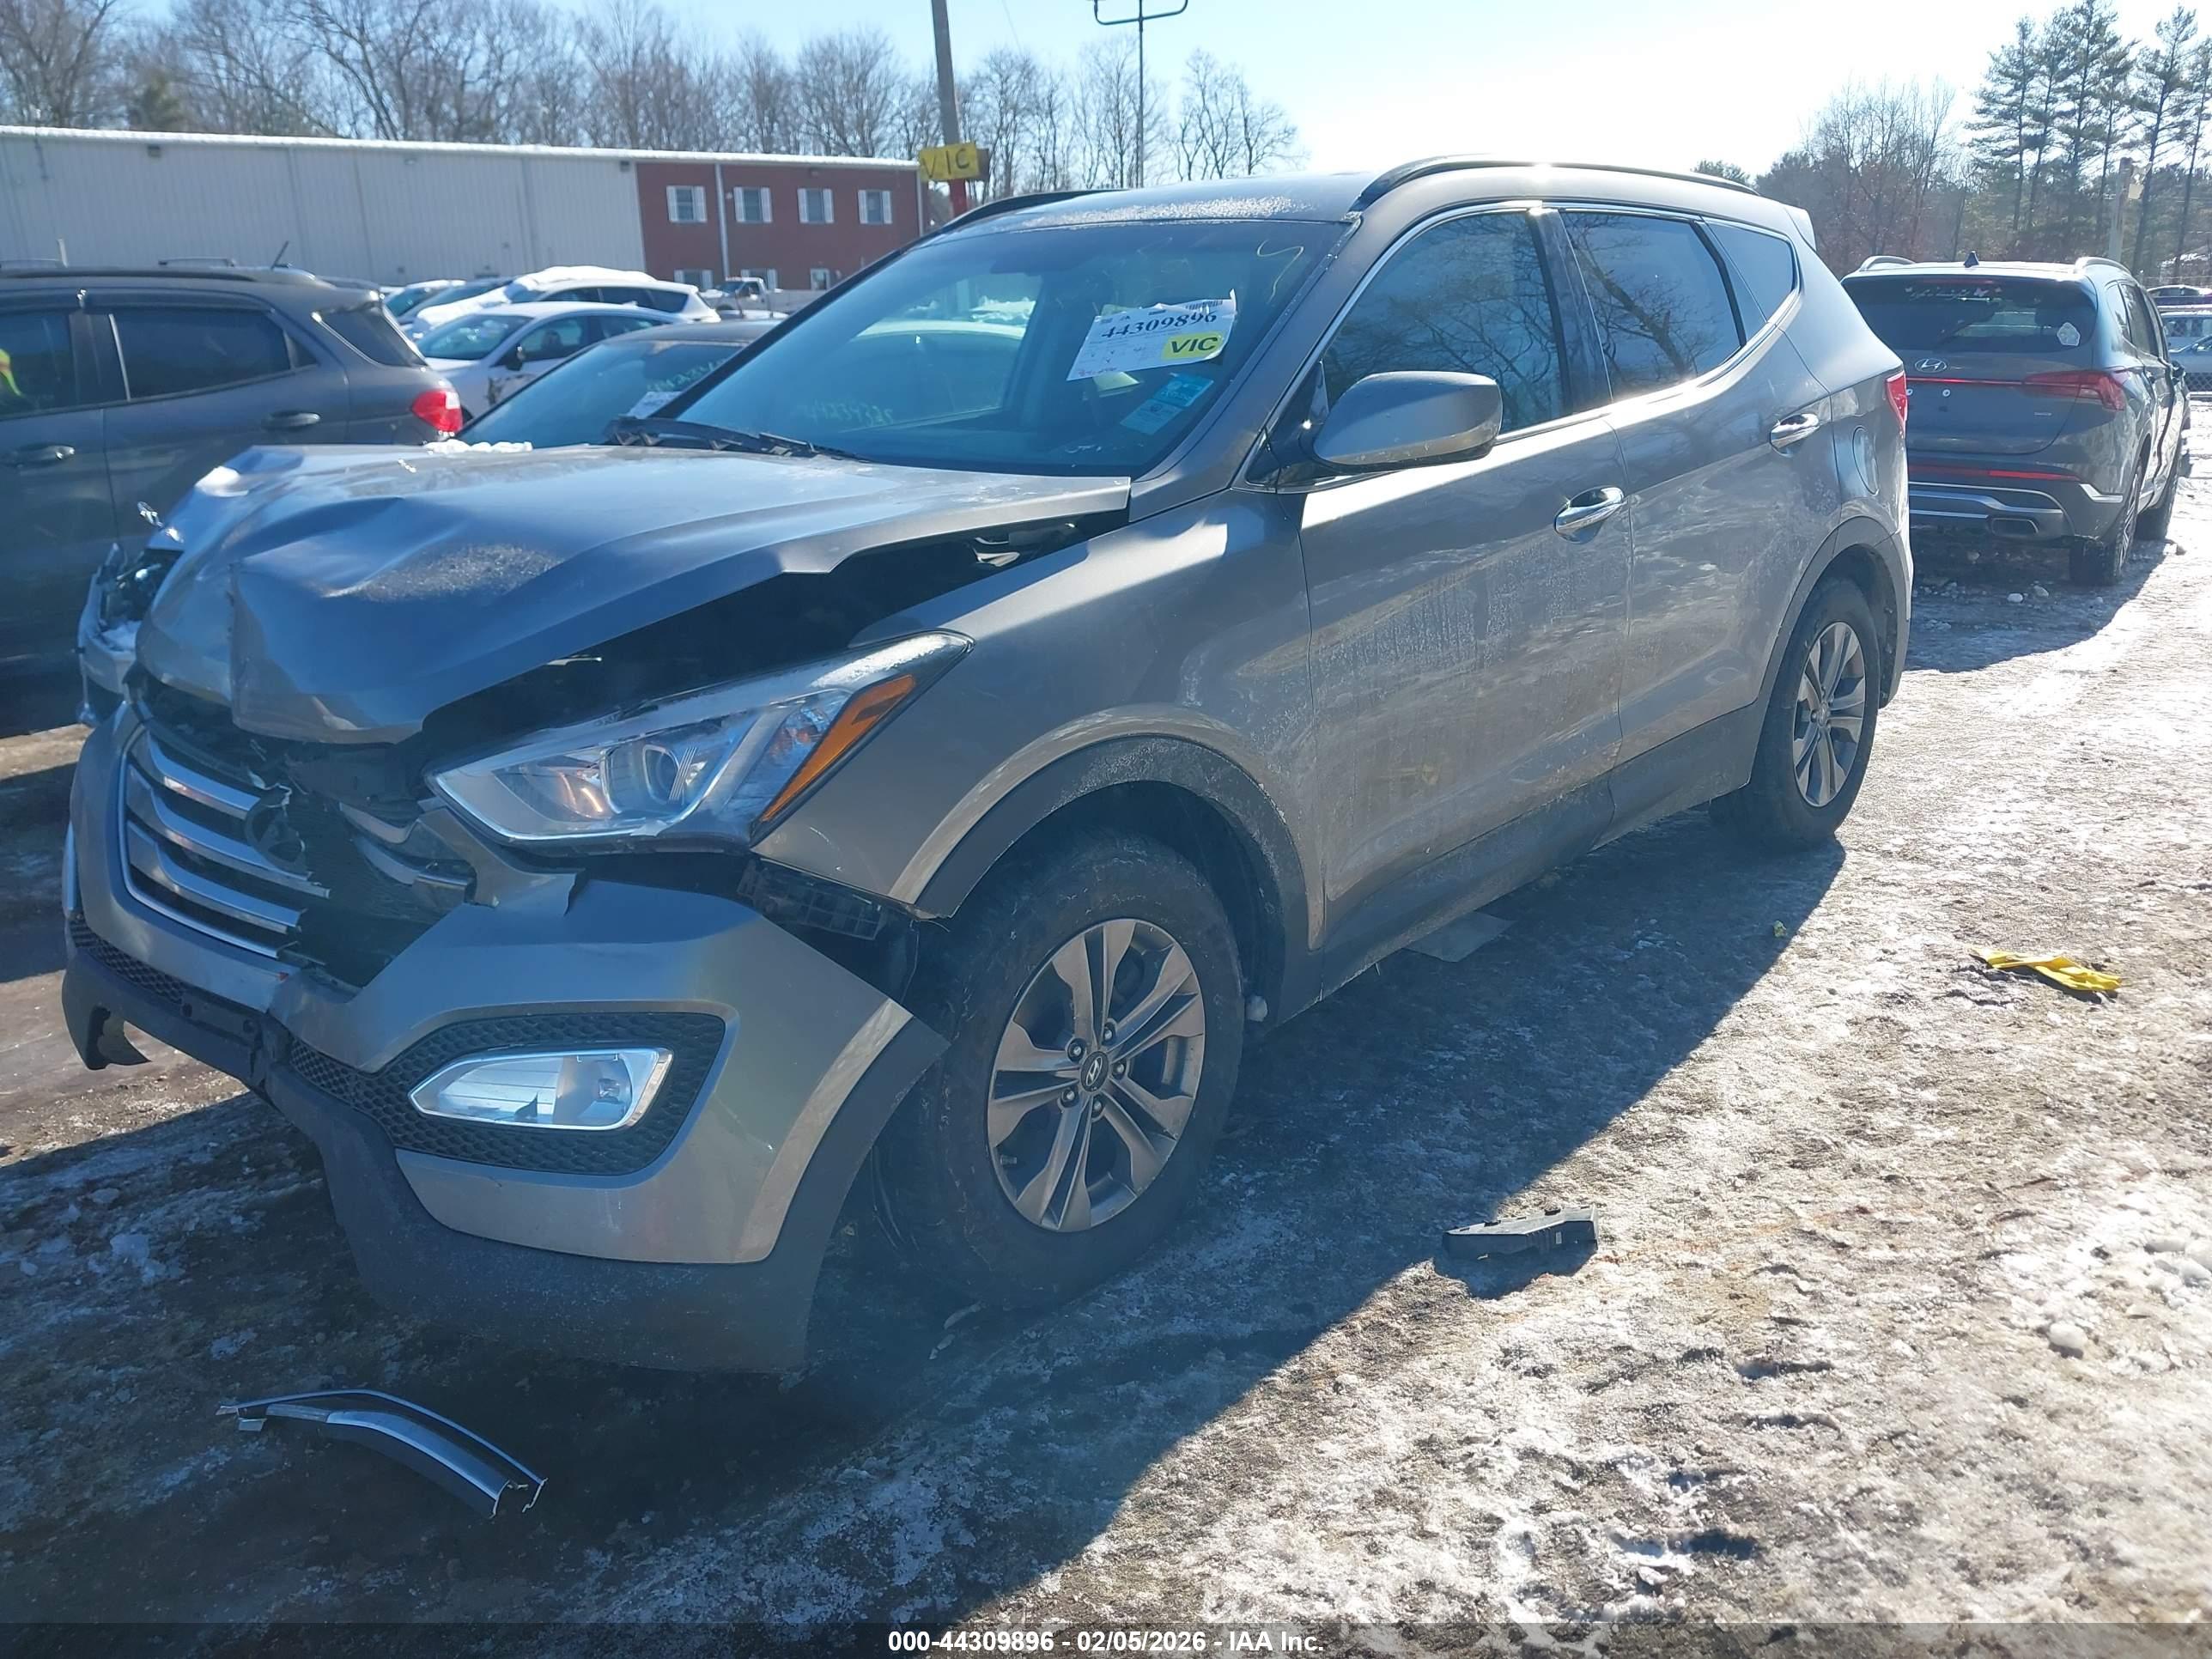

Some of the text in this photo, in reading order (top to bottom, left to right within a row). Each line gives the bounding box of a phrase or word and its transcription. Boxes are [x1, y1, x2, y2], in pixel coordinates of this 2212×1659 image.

[921, 148, 970, 179] VIC
[1101, 310, 1217, 338] 44309896
[1170, 337, 1218, 354] VIC
